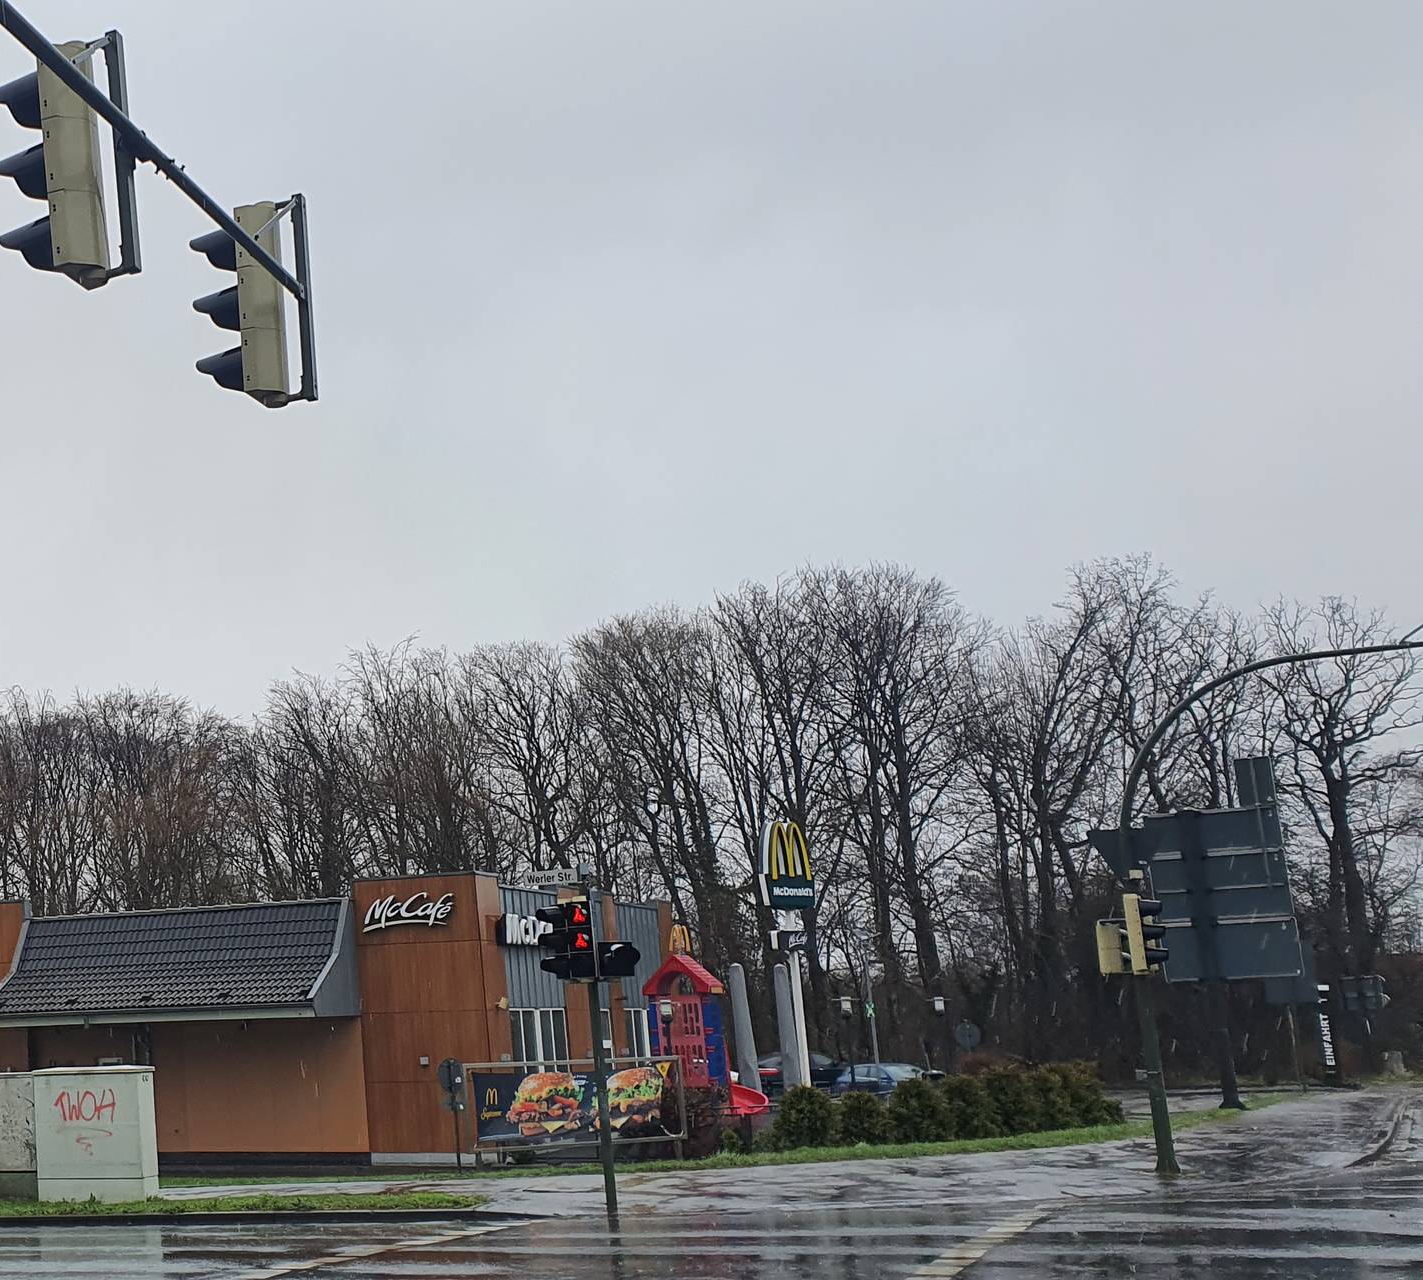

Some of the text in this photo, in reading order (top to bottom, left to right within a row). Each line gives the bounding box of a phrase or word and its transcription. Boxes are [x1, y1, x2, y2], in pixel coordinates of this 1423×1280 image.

[527, 871, 575, 884] Werler Str.
[773, 886, 813, 897] McDonald's
[363, 892, 455, 931] McCafé
[1319, 1013, 1336, 1066] EINFAHRT
